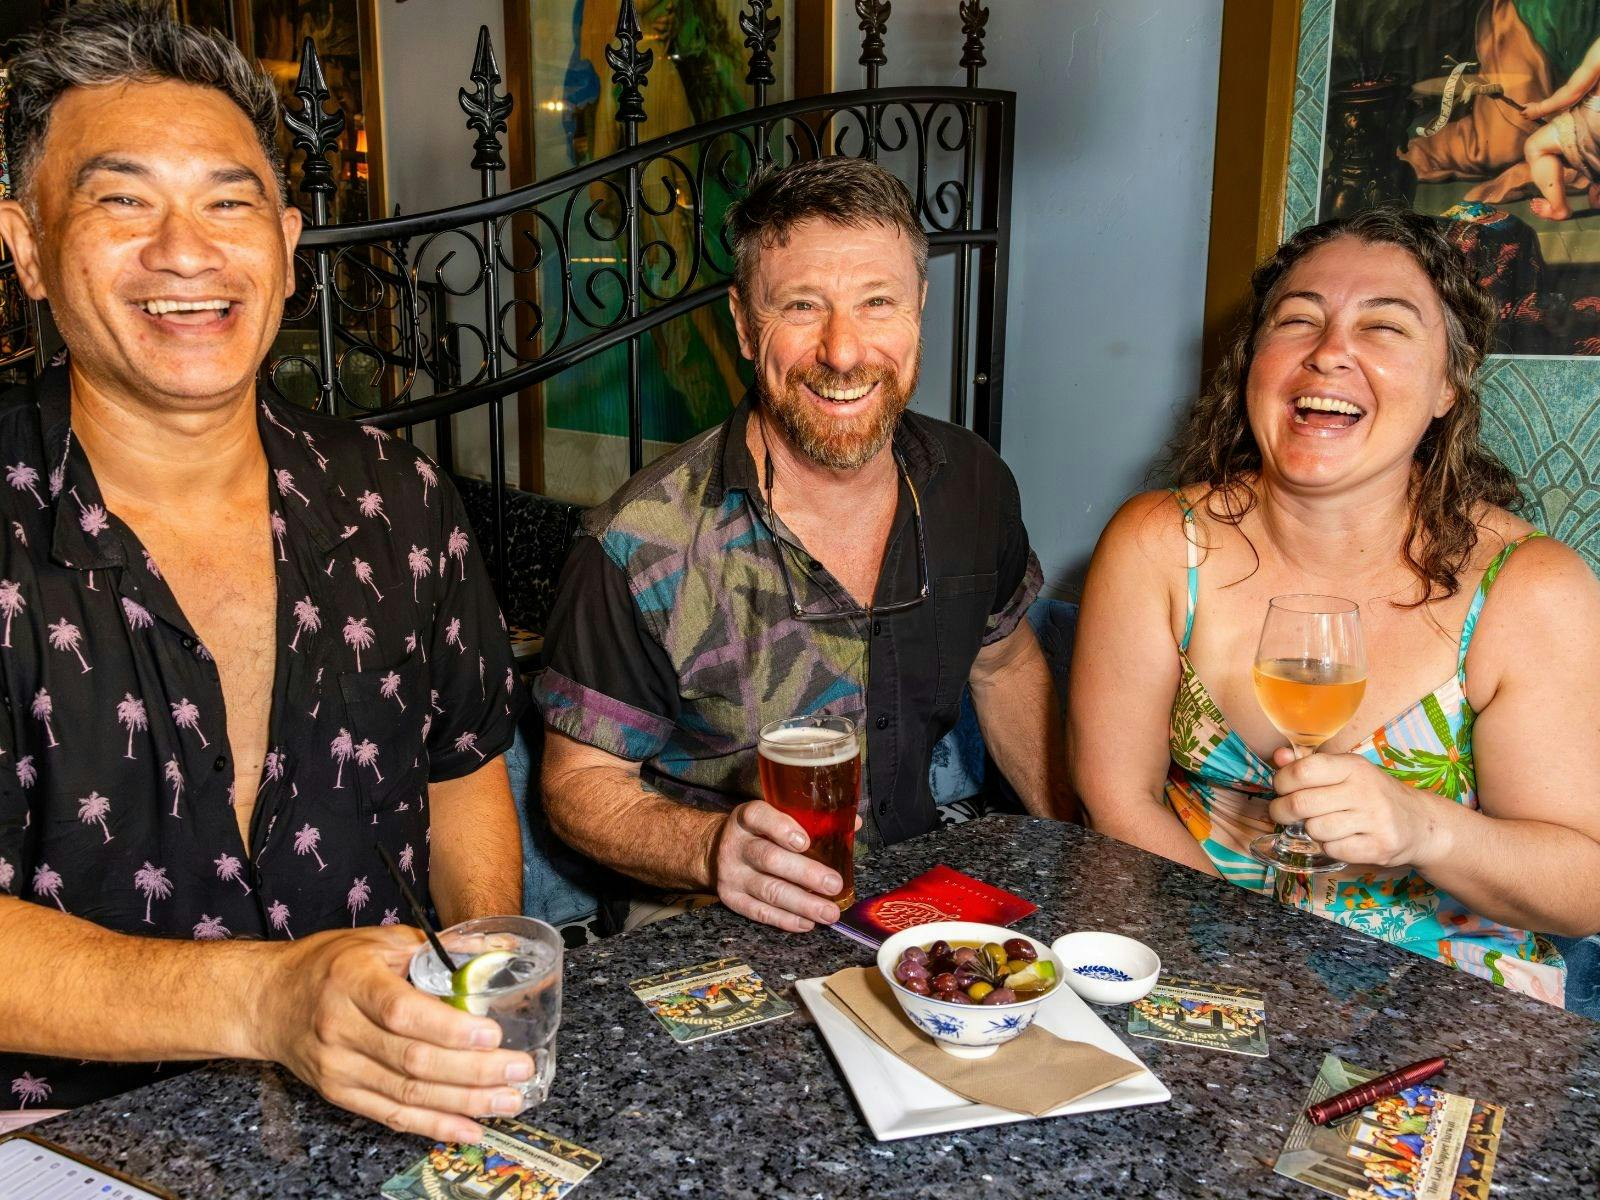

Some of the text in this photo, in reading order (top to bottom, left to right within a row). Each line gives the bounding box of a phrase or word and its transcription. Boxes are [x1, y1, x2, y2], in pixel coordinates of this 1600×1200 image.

[670, 993, 768, 1026] The Last Supper
[723, 1014, 764, 1028] Welcome
[1193, 1031, 1228, 1041] Last
[1229, 1026, 1256, 1038] The
[1168, 1033, 1230, 1049] Welcome to
[1441, 1121, 1456, 1143] Darwin
[1436, 1144, 1450, 1166] Supper
[1431, 1166, 1443, 1181] Last
[1427, 1181, 1439, 1194] The
